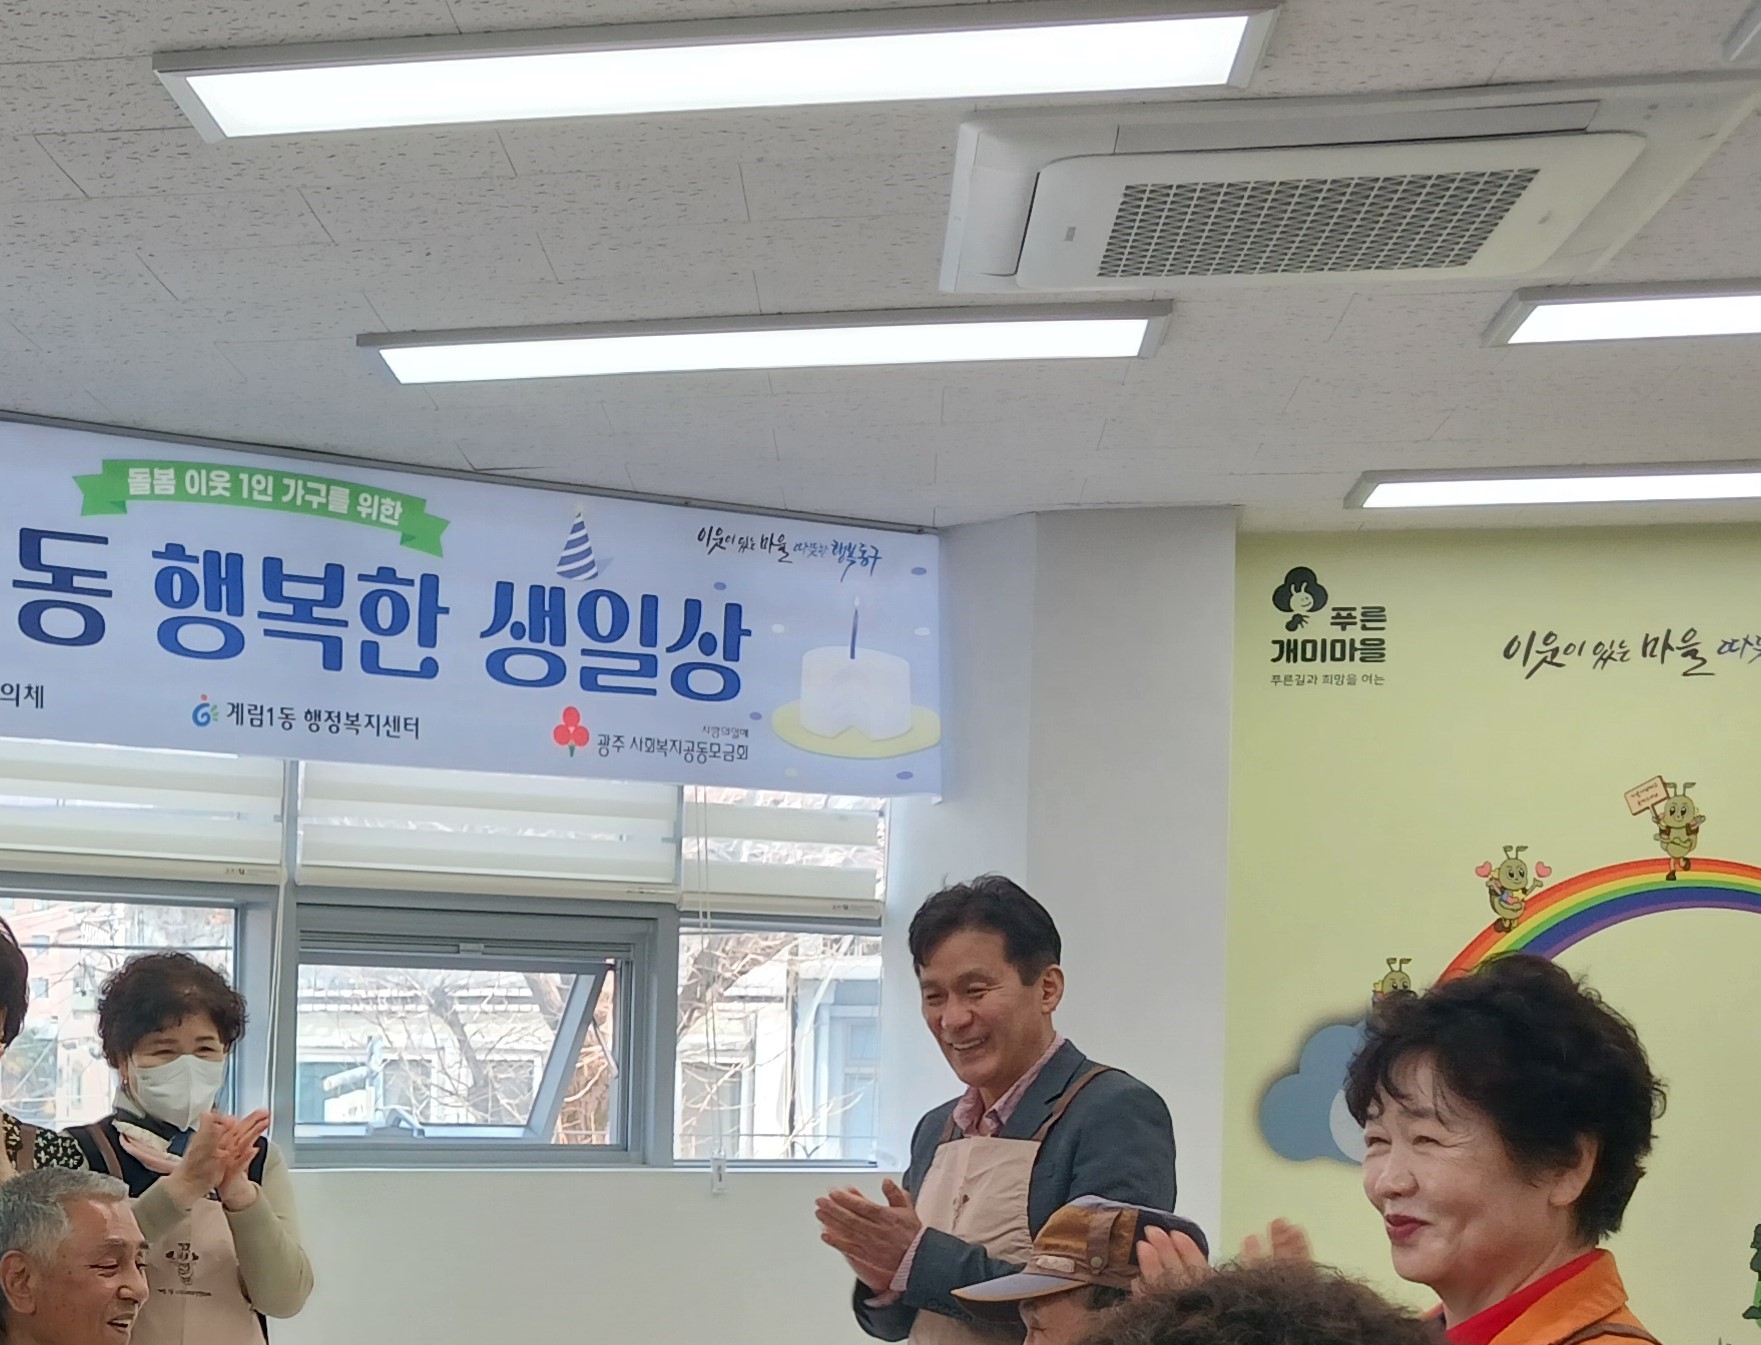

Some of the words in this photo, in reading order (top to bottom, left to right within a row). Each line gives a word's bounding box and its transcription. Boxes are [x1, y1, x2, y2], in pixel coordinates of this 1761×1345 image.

[127, 467, 176, 496] 돌봄
[184, 468, 232, 498] 이웃
[238, 473, 274, 502] 1인
[281, 477, 350, 515] 가구를
[356, 491, 403, 527] 위한
[697, 525, 736, 556] 이웃이
[759, 532, 794, 564] 마을
[151, 541, 451, 680] 행복한
[479, 580, 753, 703] 생일상
[1329, 605, 1387, 632] 푸른
[1270, 637, 1386, 664] 개미마을
[1502, 630, 1587, 680] 이웃이
[1591, 638, 1631, 670] 있는
[1640, 627, 1716, 677] 마을
[1321, 673, 1358, 687] 희망을
[1361, 672, 1386, 686] 여는
[226, 701, 297, 732] 계림1동
[303, 707, 421, 741] 행정복지센터
[597, 733, 626, 759] 광주
[629, 736, 750, 765] 사회복지공동모금회
